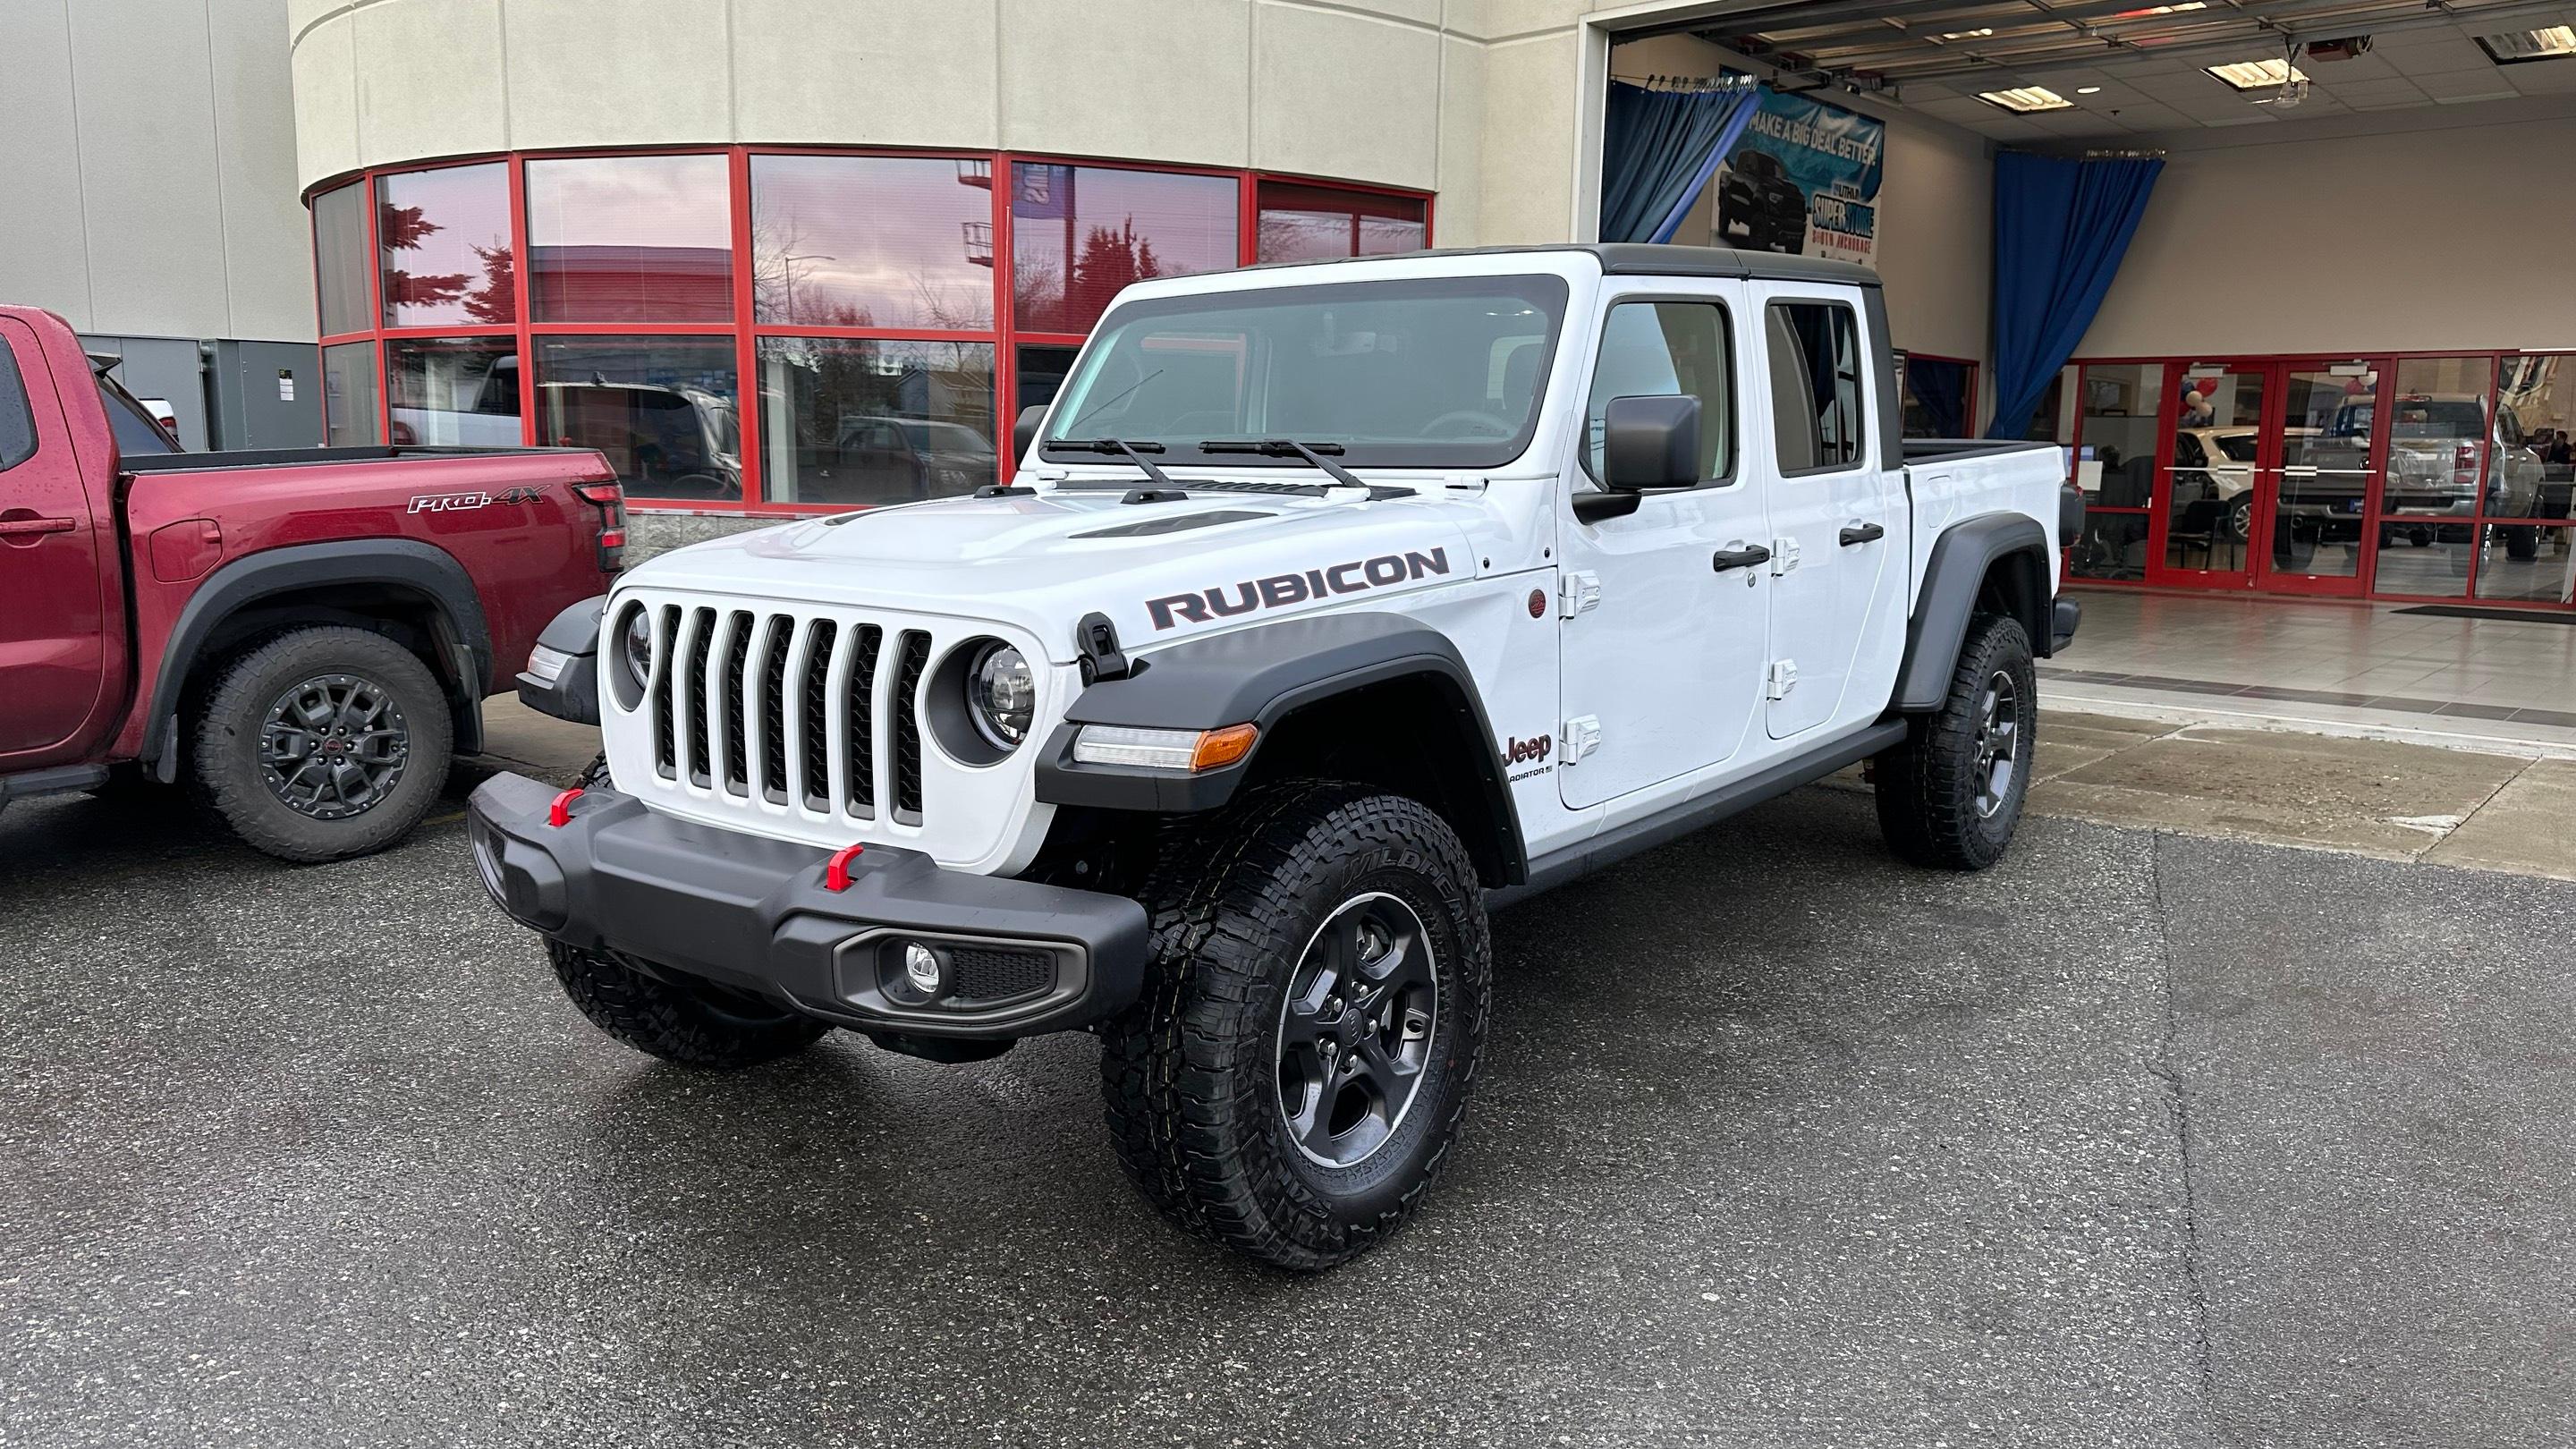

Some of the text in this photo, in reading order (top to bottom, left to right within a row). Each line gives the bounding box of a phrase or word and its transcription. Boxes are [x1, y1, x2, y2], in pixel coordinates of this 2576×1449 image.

[1749, 110, 1784, 138] MAKE
[1782, 120, 1790, 141] A
[1792, 122, 1810, 147] BIG
[1810, 129, 1837, 155] DEAL
[1145, 547, 1451, 631] RUBICON
[1502, 733, 1552, 767] Jeep
[1509, 767, 1546, 784] ADIATOR
[1340, 846, 1475, 945] WILDPEAK
